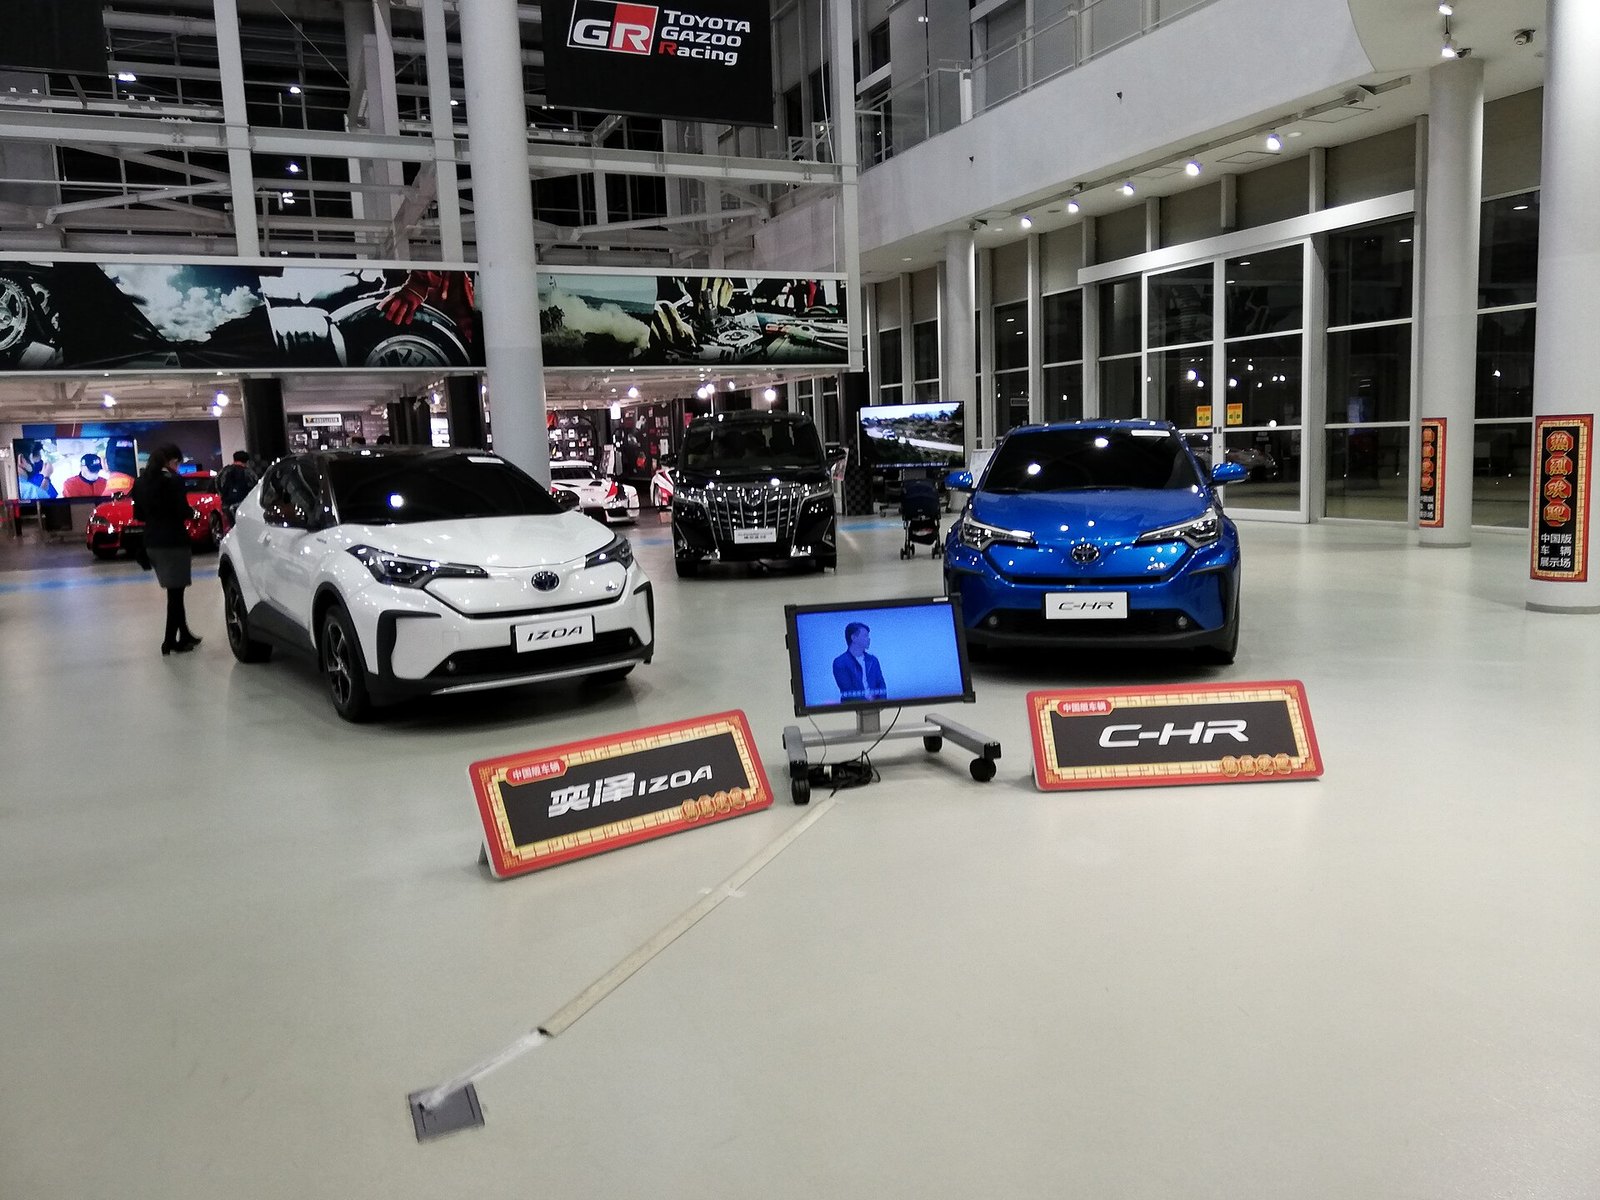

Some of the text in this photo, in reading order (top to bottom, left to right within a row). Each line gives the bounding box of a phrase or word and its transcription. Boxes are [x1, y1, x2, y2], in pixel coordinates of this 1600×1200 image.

[662, 9, 751, 33] TOYOTA
[573, 19, 650, 52] GR
[660, 26, 742, 48] GAZOO
[658, 41, 738, 66] Racing
[1540, 533, 1572, 544] 中国版
[1540, 557, 1571, 568] 展示场
[1058, 602, 1114, 611] C-HR
[527, 625, 583, 642] IZOA
[1098, 719, 1250, 749] C-HR
